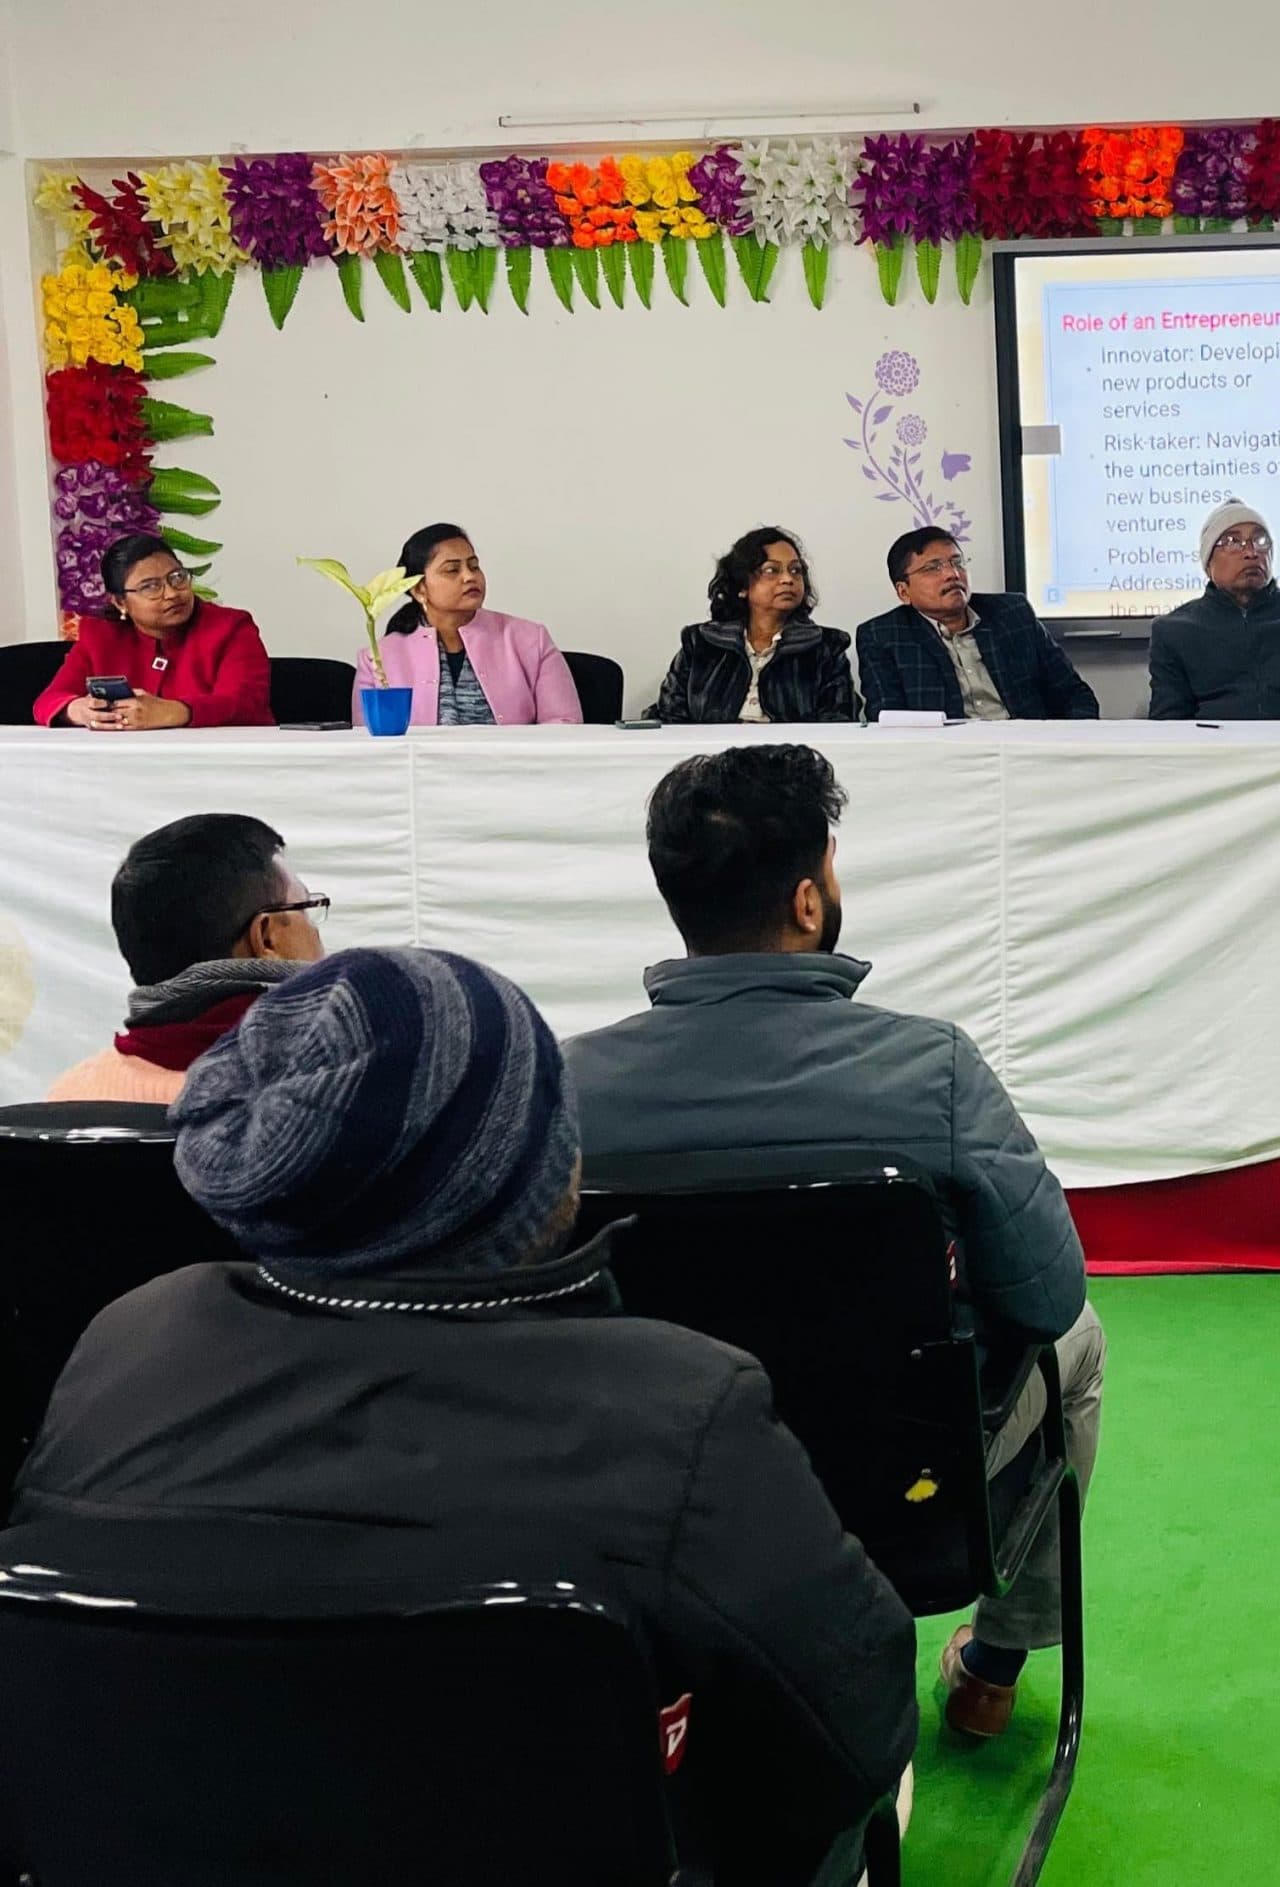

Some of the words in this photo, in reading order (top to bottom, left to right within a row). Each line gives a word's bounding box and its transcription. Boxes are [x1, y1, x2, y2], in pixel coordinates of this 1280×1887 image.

[1062, 313, 1103, 332] Role
[1109, 312, 1128, 331] of
[1134, 314, 1155, 331] an
[1101, 345, 1194, 364] Innovator:
[1102, 376, 1139, 392] new
[1146, 371, 1227, 394] products
[1233, 372, 1252, 389] or
[1102, 401, 1181, 419] services
[1104, 432, 1200, 451] Risk-taker:
[1104, 461, 1134, 479] the
[1140, 458, 1260, 477] uncertainties
[1106, 491, 1144, 505] new
[1149, 486, 1233, 505] business
[1106, 516, 1186, 533] ventures
[1108, 546, 1201, 565] Problem-s
